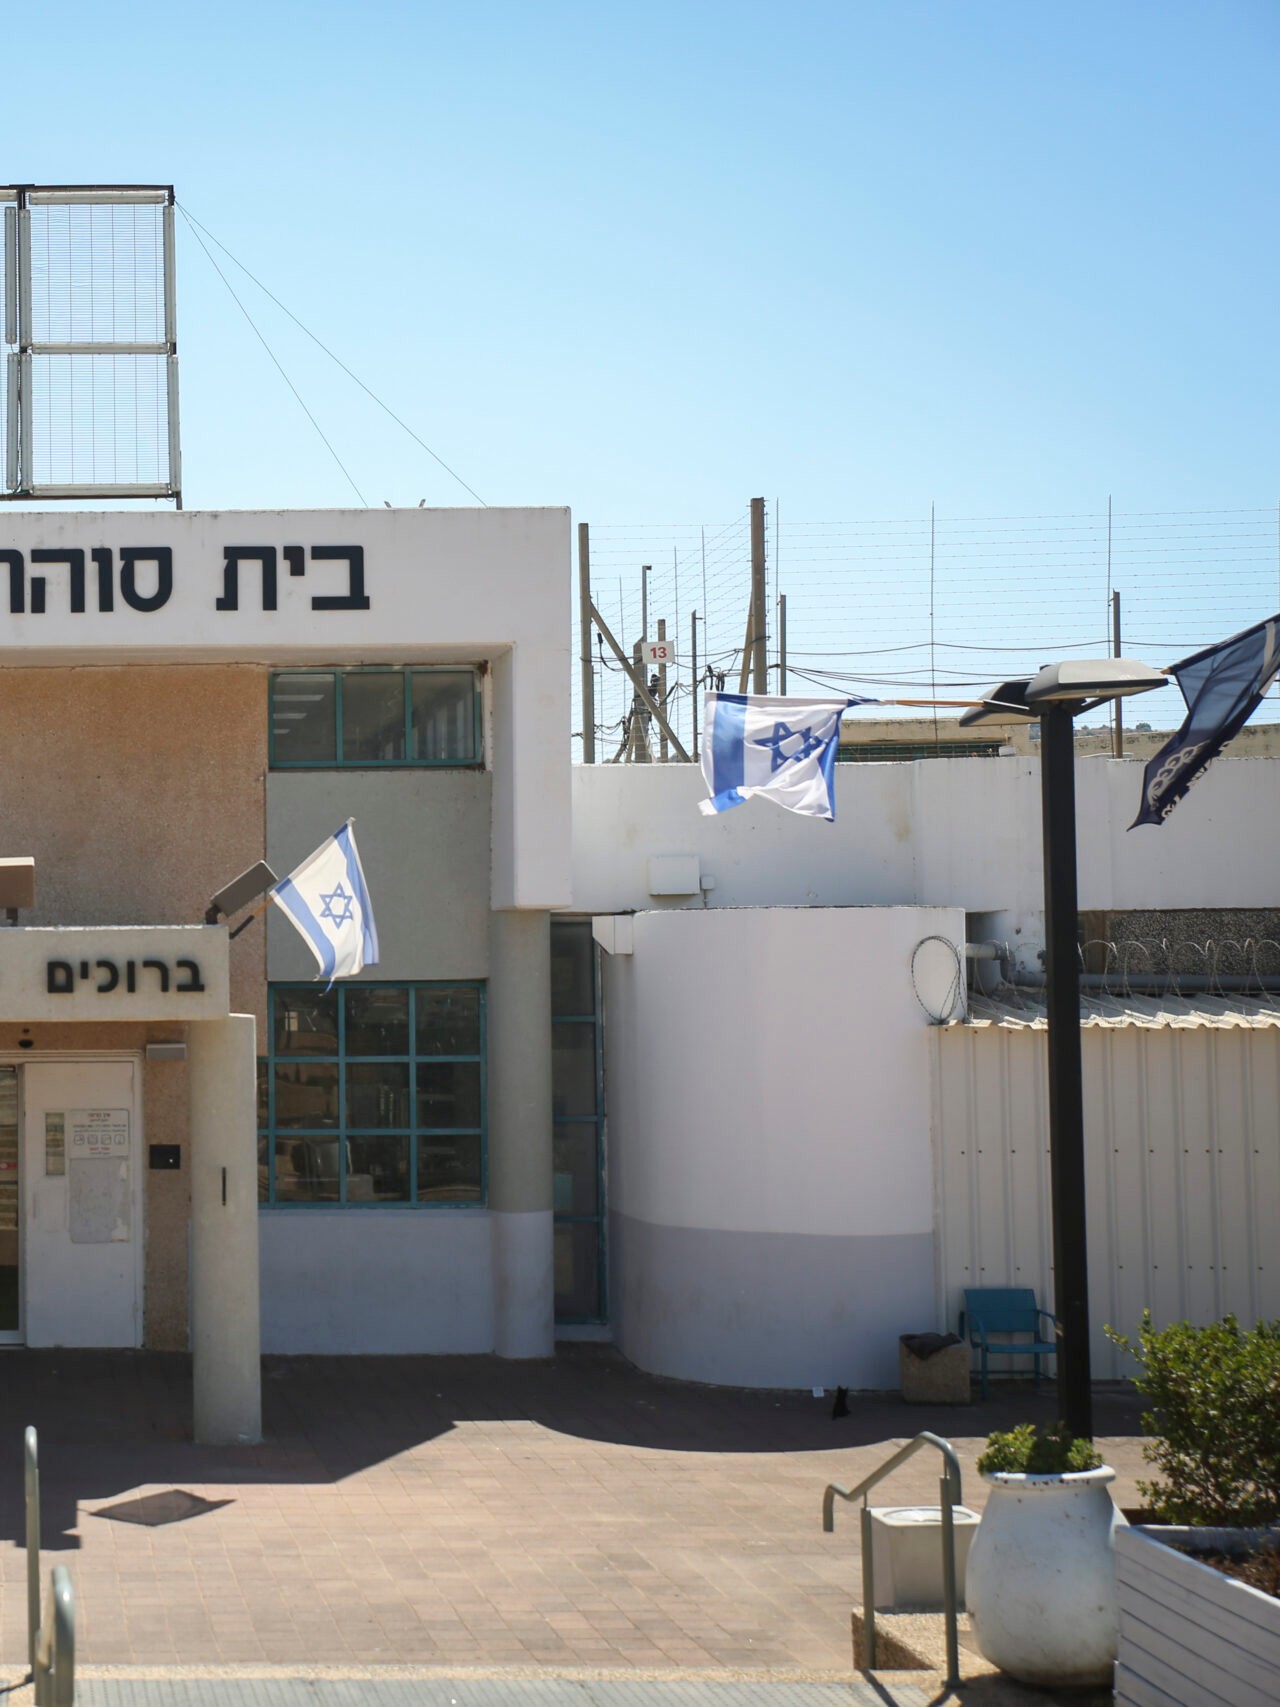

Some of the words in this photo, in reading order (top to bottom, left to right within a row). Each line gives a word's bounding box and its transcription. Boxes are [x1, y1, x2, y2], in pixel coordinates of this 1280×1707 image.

[216, 545, 370, 611] בית
[650, 646, 667, 659] 13
[47, 959, 205, 993] ברוכים
